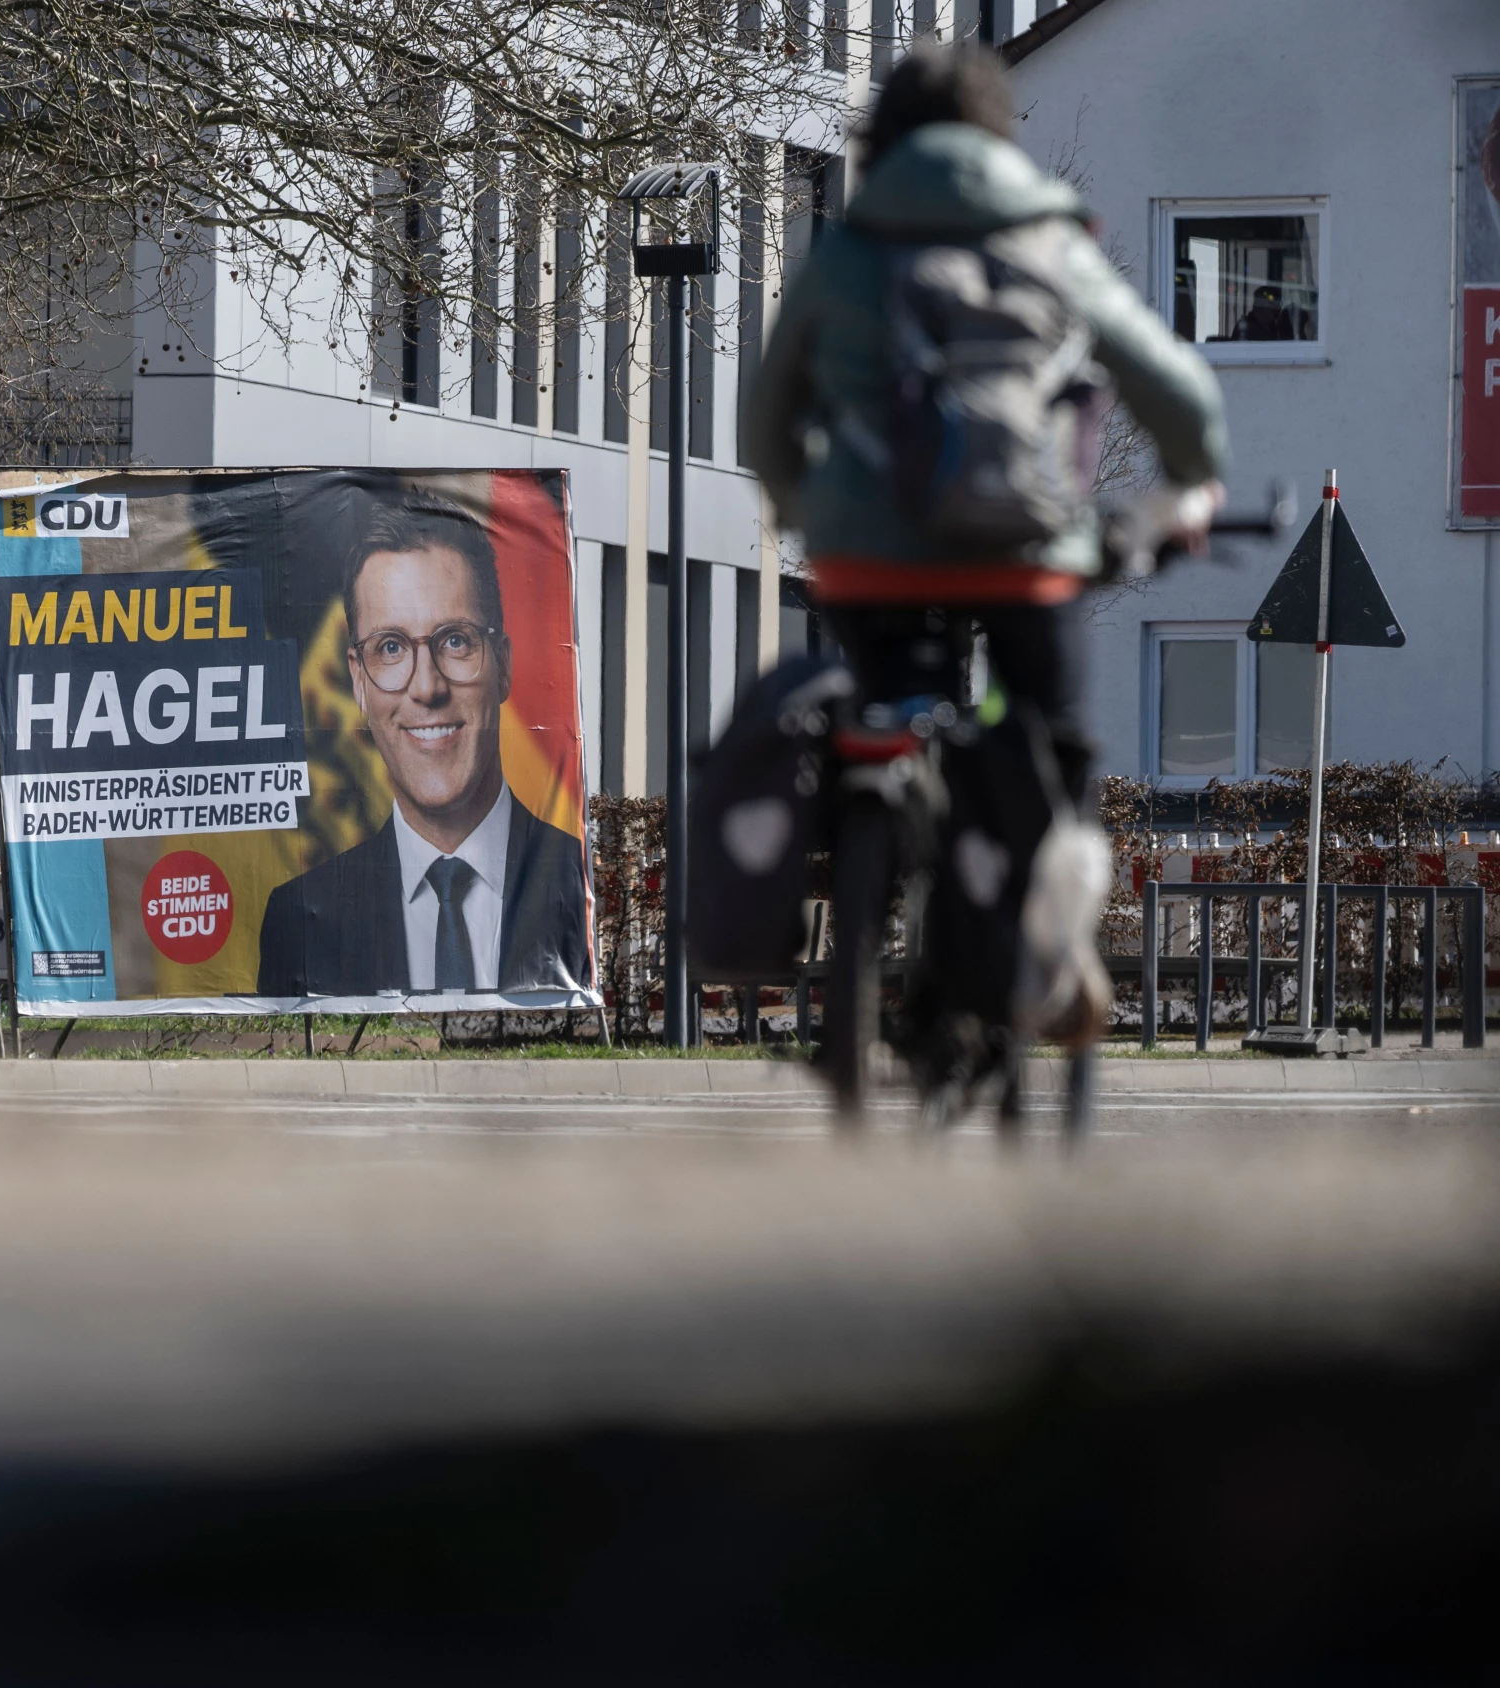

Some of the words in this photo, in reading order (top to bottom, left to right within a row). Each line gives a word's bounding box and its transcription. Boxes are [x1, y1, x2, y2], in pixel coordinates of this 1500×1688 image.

[40, 499, 122, 531] CDU
[8, 585, 248, 647] MANUEL
[15, 664, 286, 751] HAGEL
[19, 769, 256, 804] MINISTERPRÄSIDENT
[260, 763, 303, 793] FÜR
[22, 801, 290, 837] BADEN-WÜRTTEMBERG
[161, 874, 211, 896] BEIDE
[147, 892, 229, 916] STIMMEN
[162, 913, 216, 938] CDU
